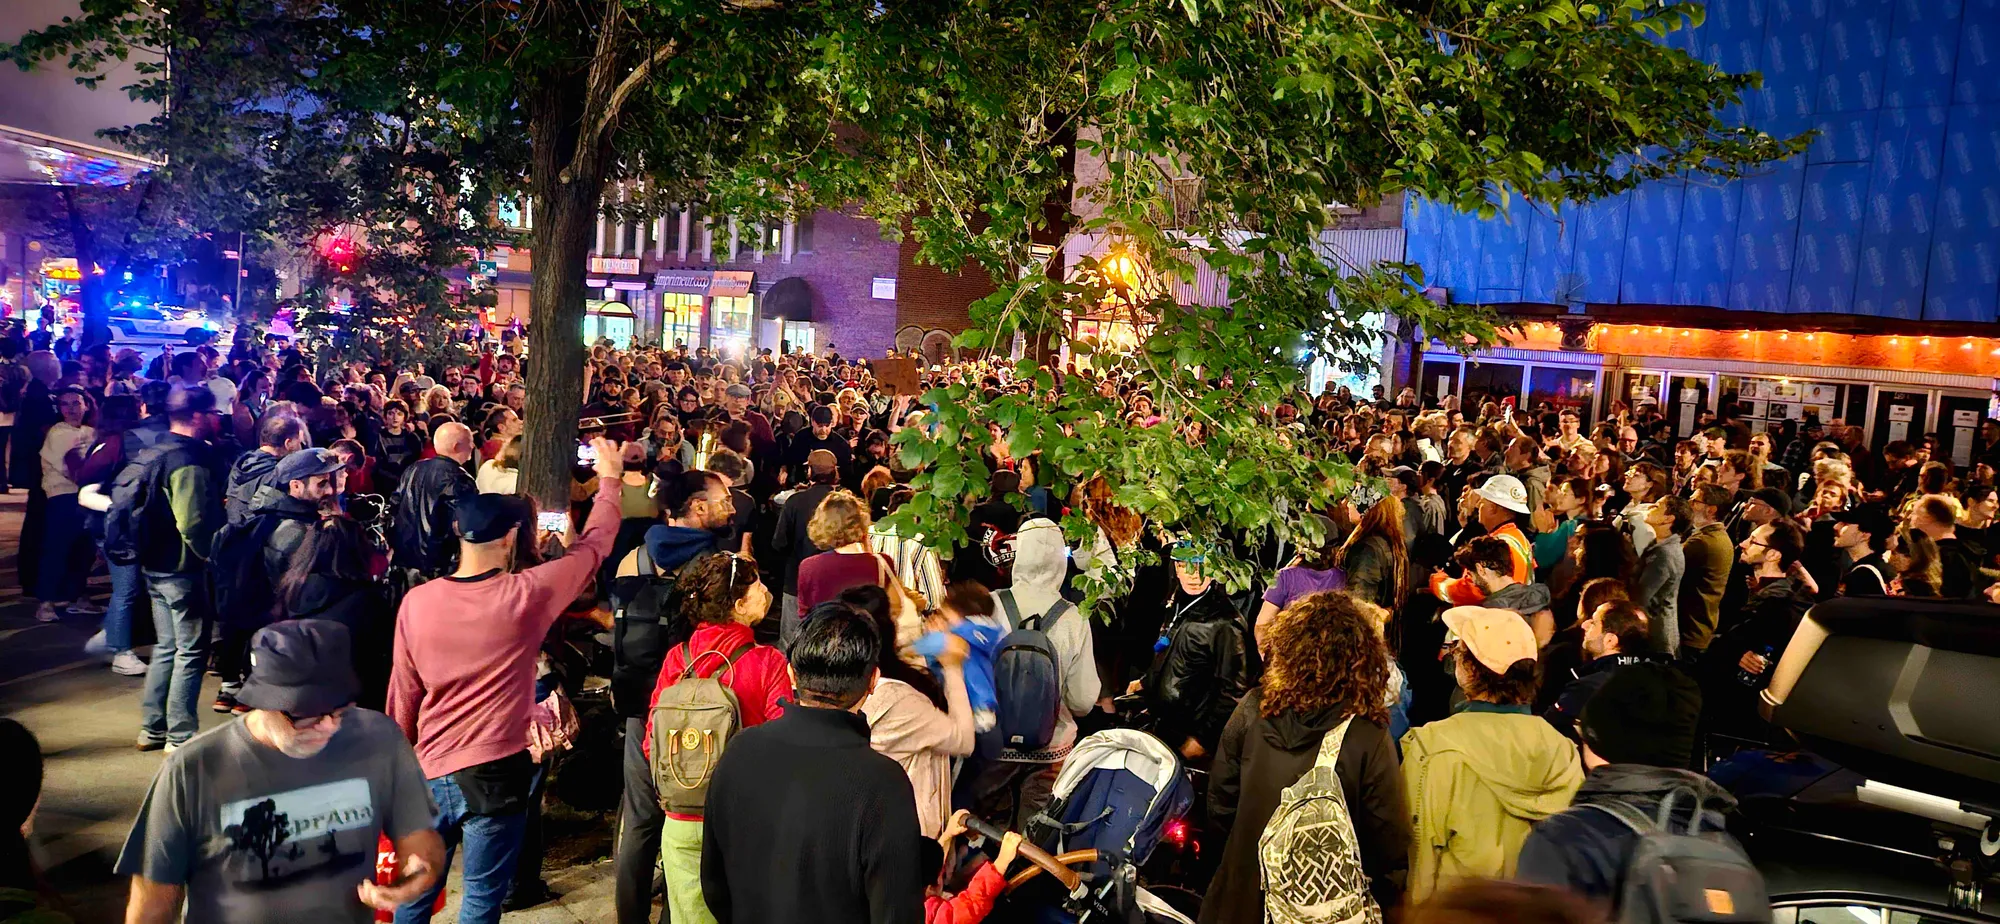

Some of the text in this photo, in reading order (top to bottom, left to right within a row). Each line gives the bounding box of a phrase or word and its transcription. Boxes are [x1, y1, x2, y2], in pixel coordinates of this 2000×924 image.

[480, 263, 487, 272] P
[295, 806, 372, 834] prAna
[1093, 900, 1109, 916] VISTA
